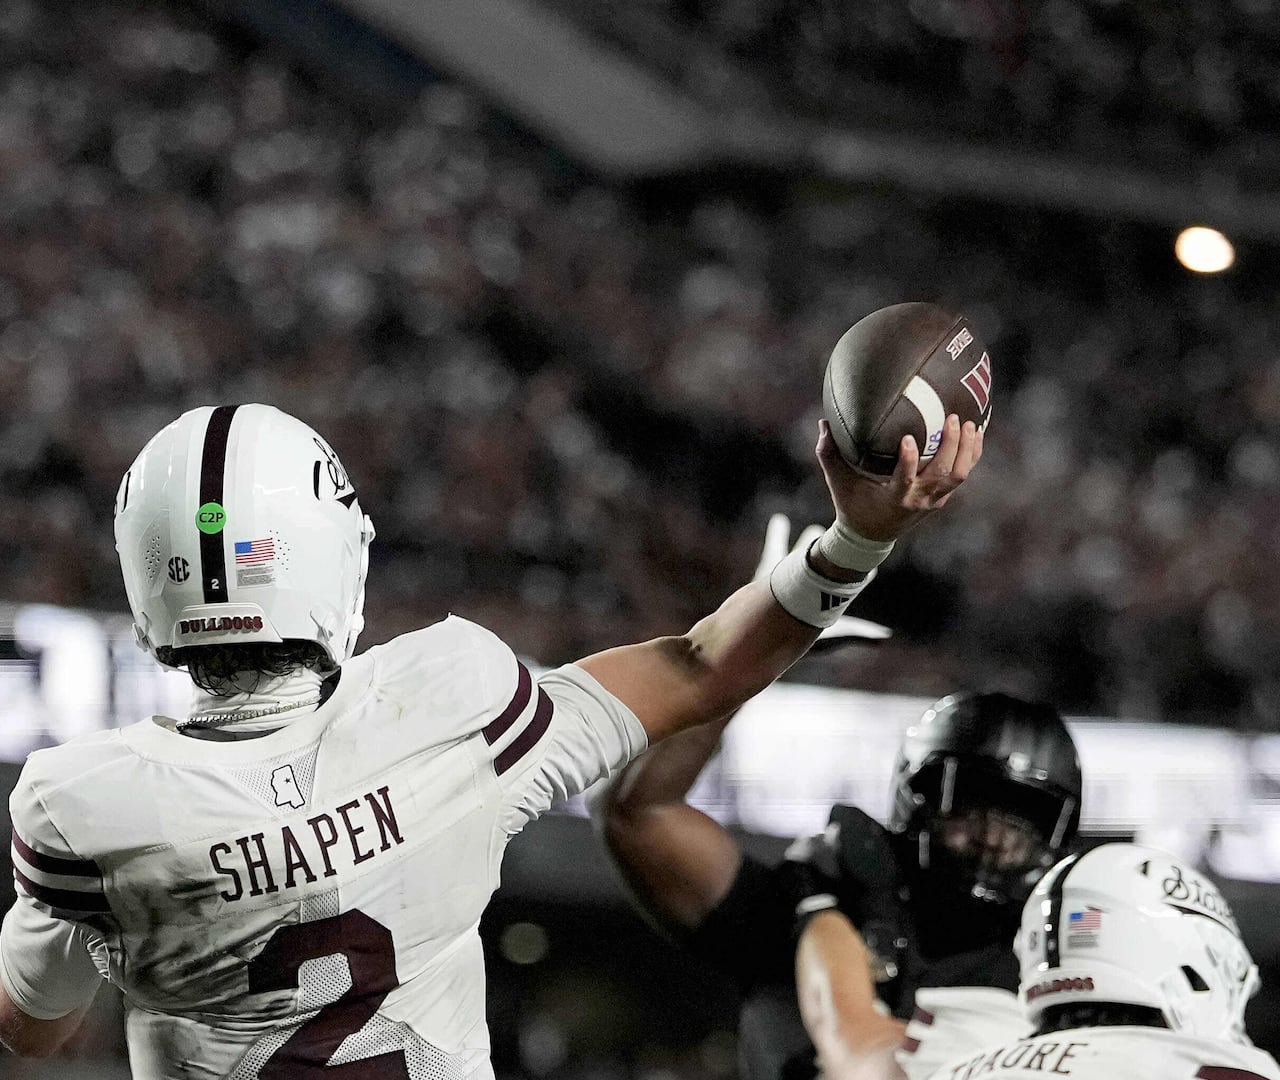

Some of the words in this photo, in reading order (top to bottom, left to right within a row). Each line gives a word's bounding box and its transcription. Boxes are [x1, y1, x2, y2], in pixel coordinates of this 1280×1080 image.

[199, 512, 223, 524] C2P
[168, 556, 190, 583] SEC
[211, 578, 220, 590] 2
[179, 616, 263, 635] BULLDOGS
[209, 785, 406, 903] SHAPEN
